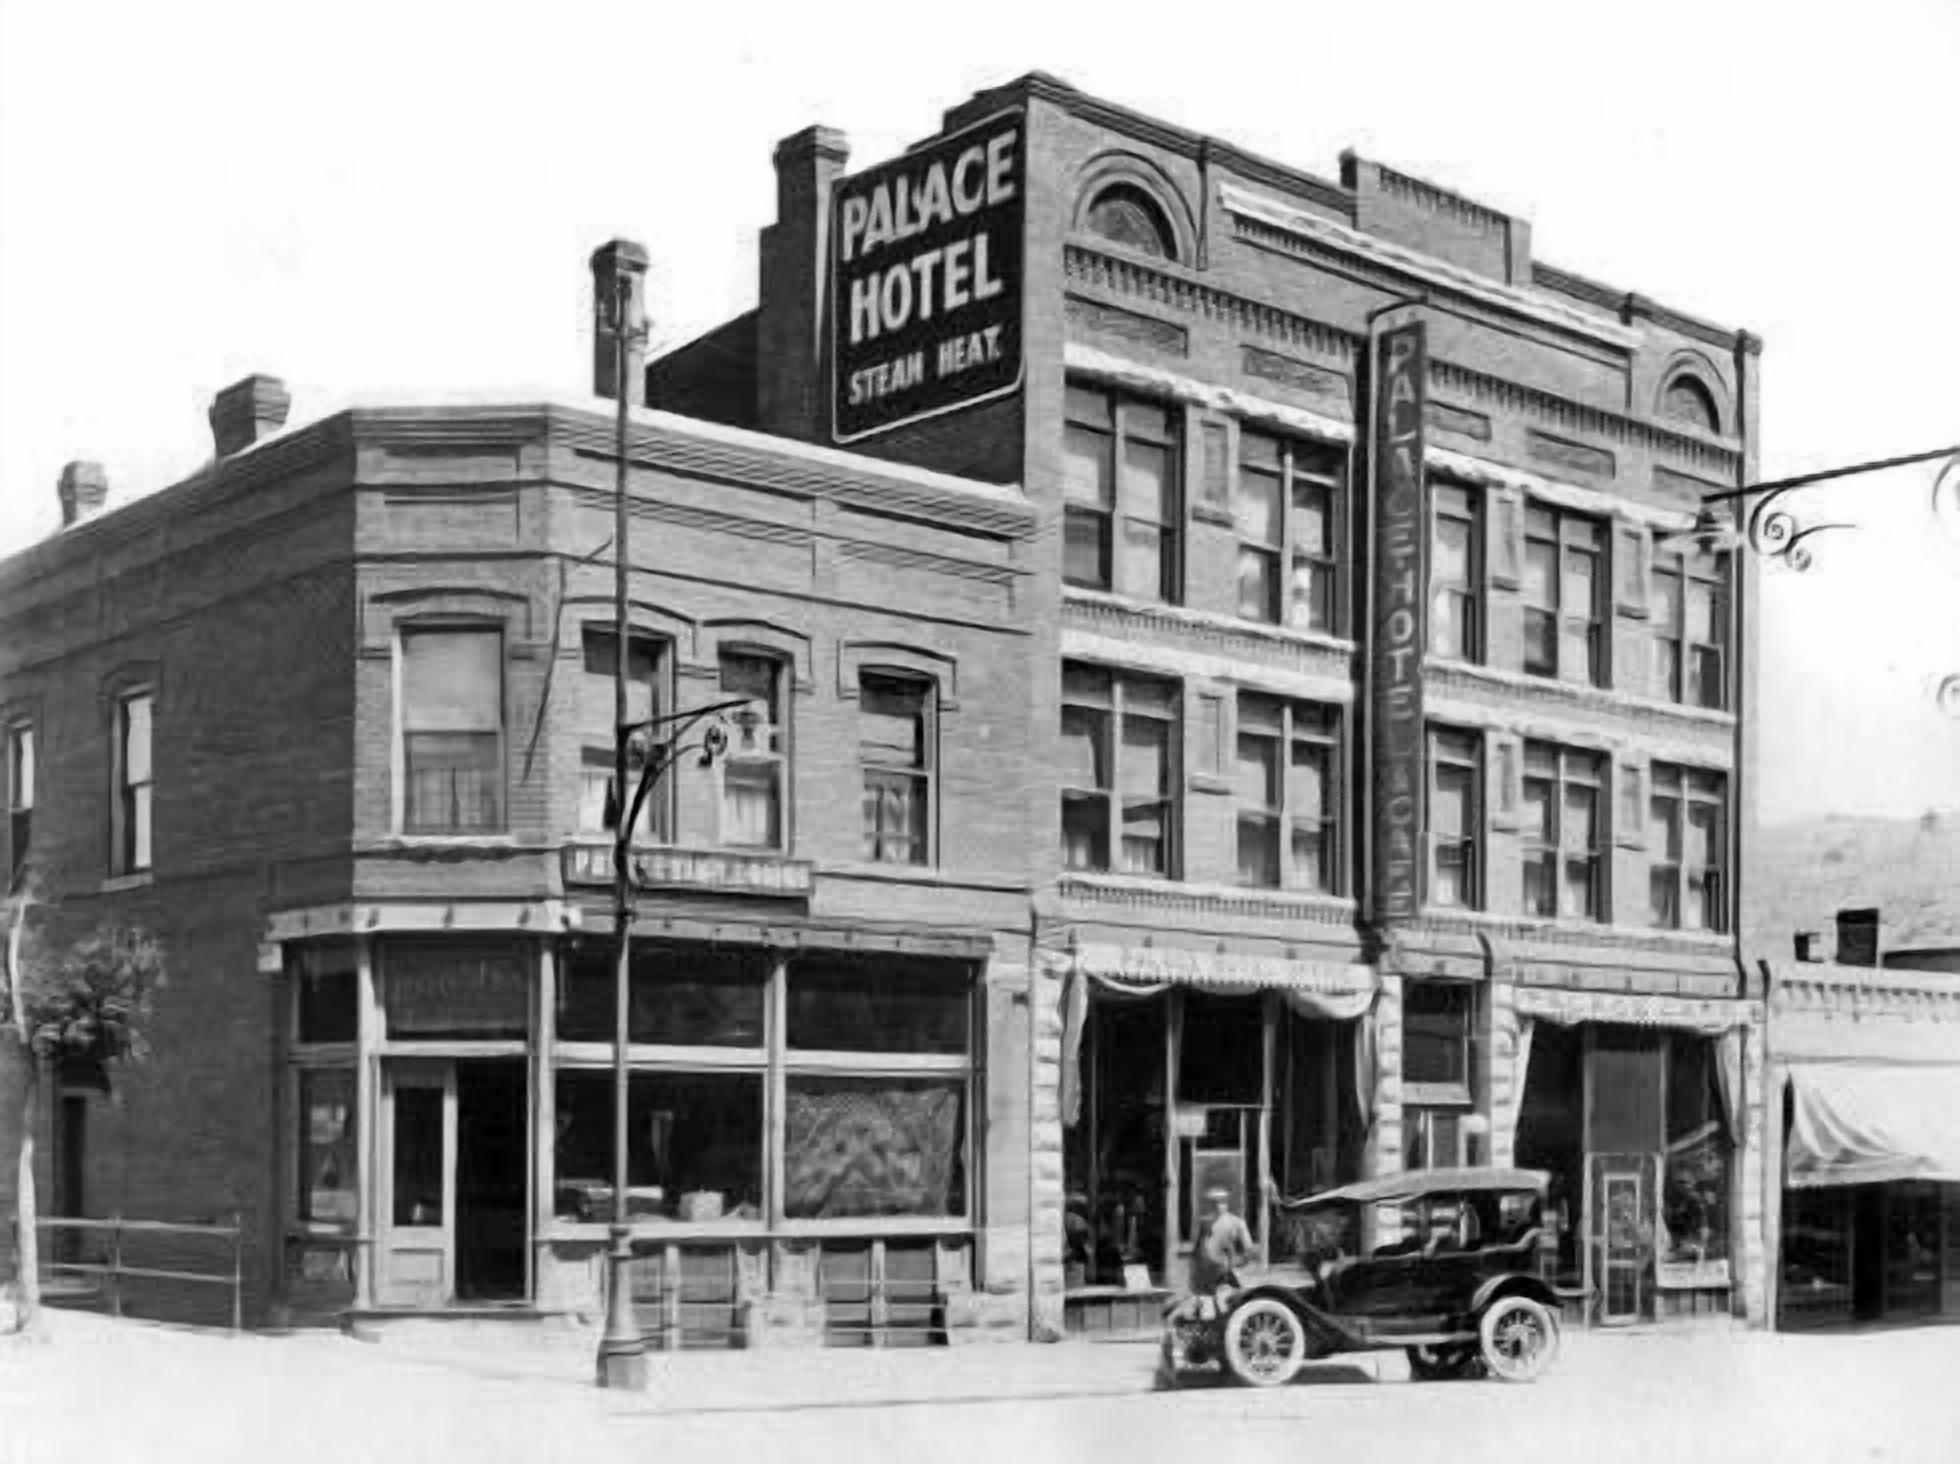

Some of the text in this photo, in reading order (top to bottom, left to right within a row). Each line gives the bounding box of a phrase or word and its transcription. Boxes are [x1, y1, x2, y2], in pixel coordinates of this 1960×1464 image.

[843, 128, 1017, 262] PALACE
[850, 232, 1002, 344] HOTEL
[849, 351, 924, 404] STEAM
[1388, 334, 1416, 557] PALACE
[1386, 569, 1415, 755] HOTEL
